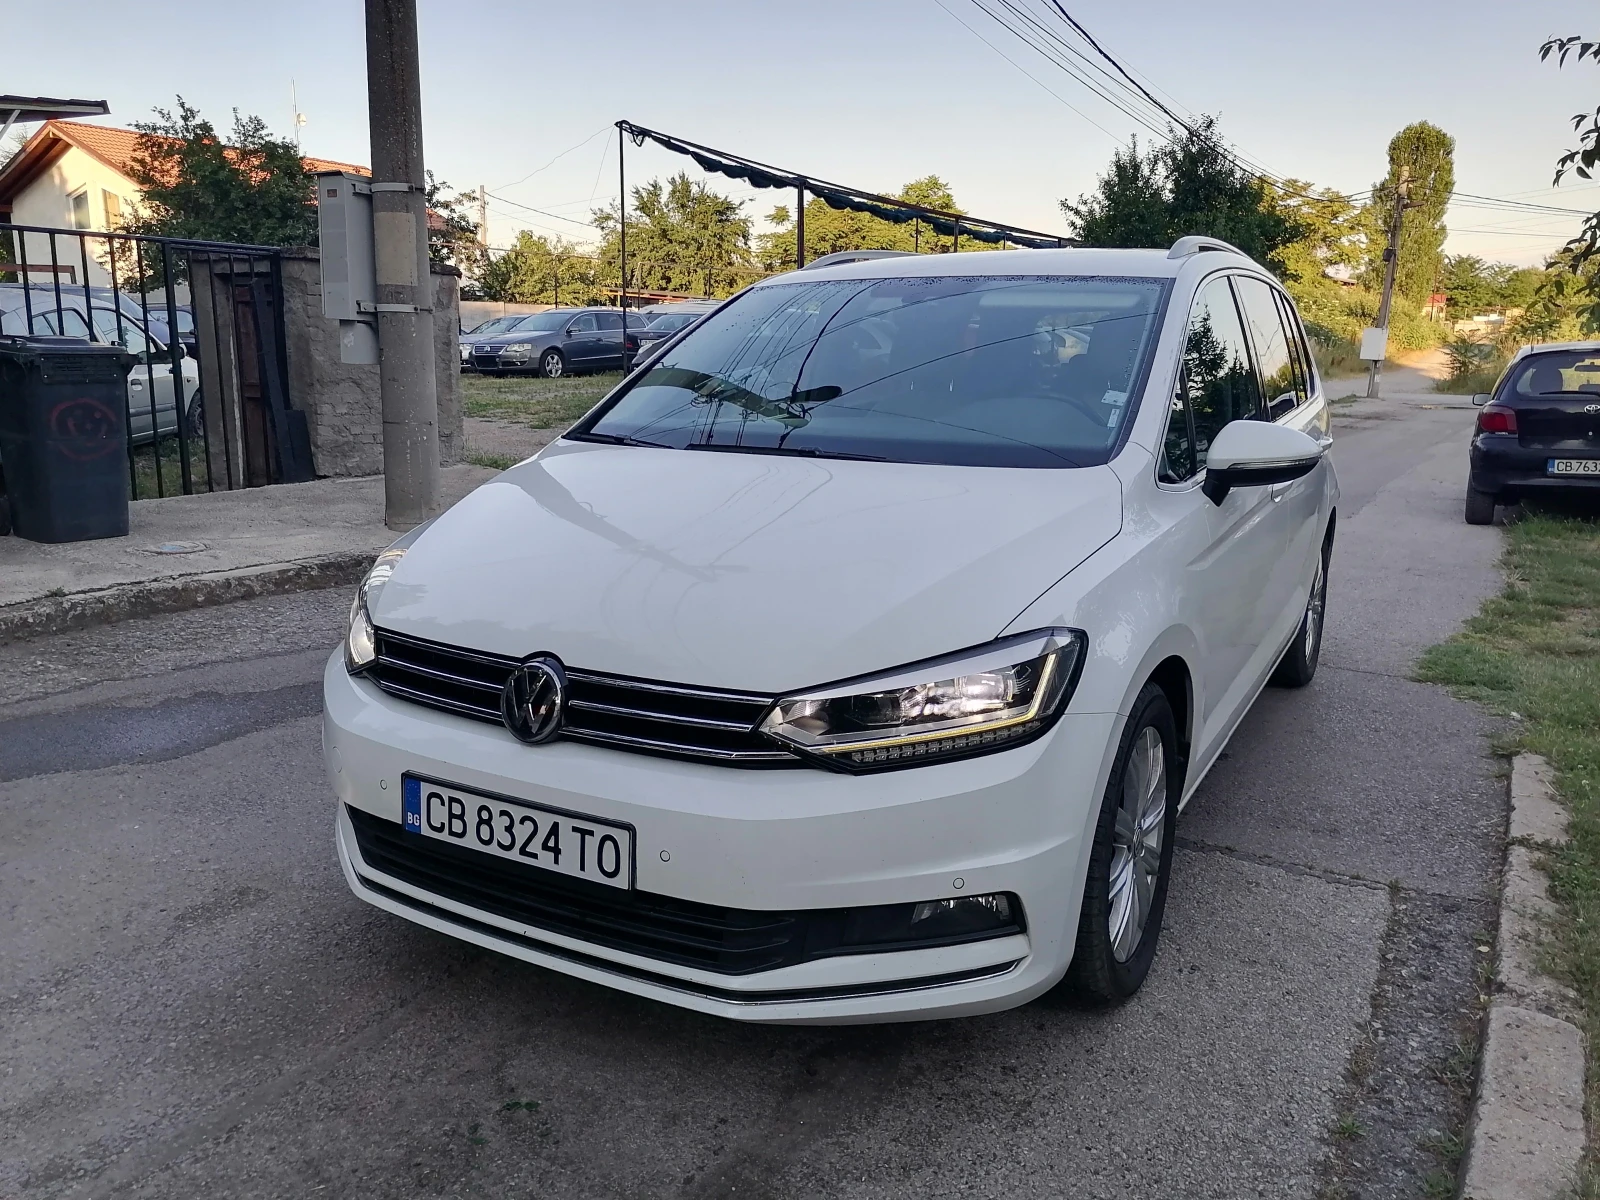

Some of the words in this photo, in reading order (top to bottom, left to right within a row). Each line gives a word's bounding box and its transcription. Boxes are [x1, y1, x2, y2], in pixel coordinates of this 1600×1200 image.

[1557, 461, 1573, 472] CB
[407, 811, 420, 826] BG
[426, 791, 468, 839] CB
[475, 804, 562, 866] 8324
[571, 825, 621, 879] TO
